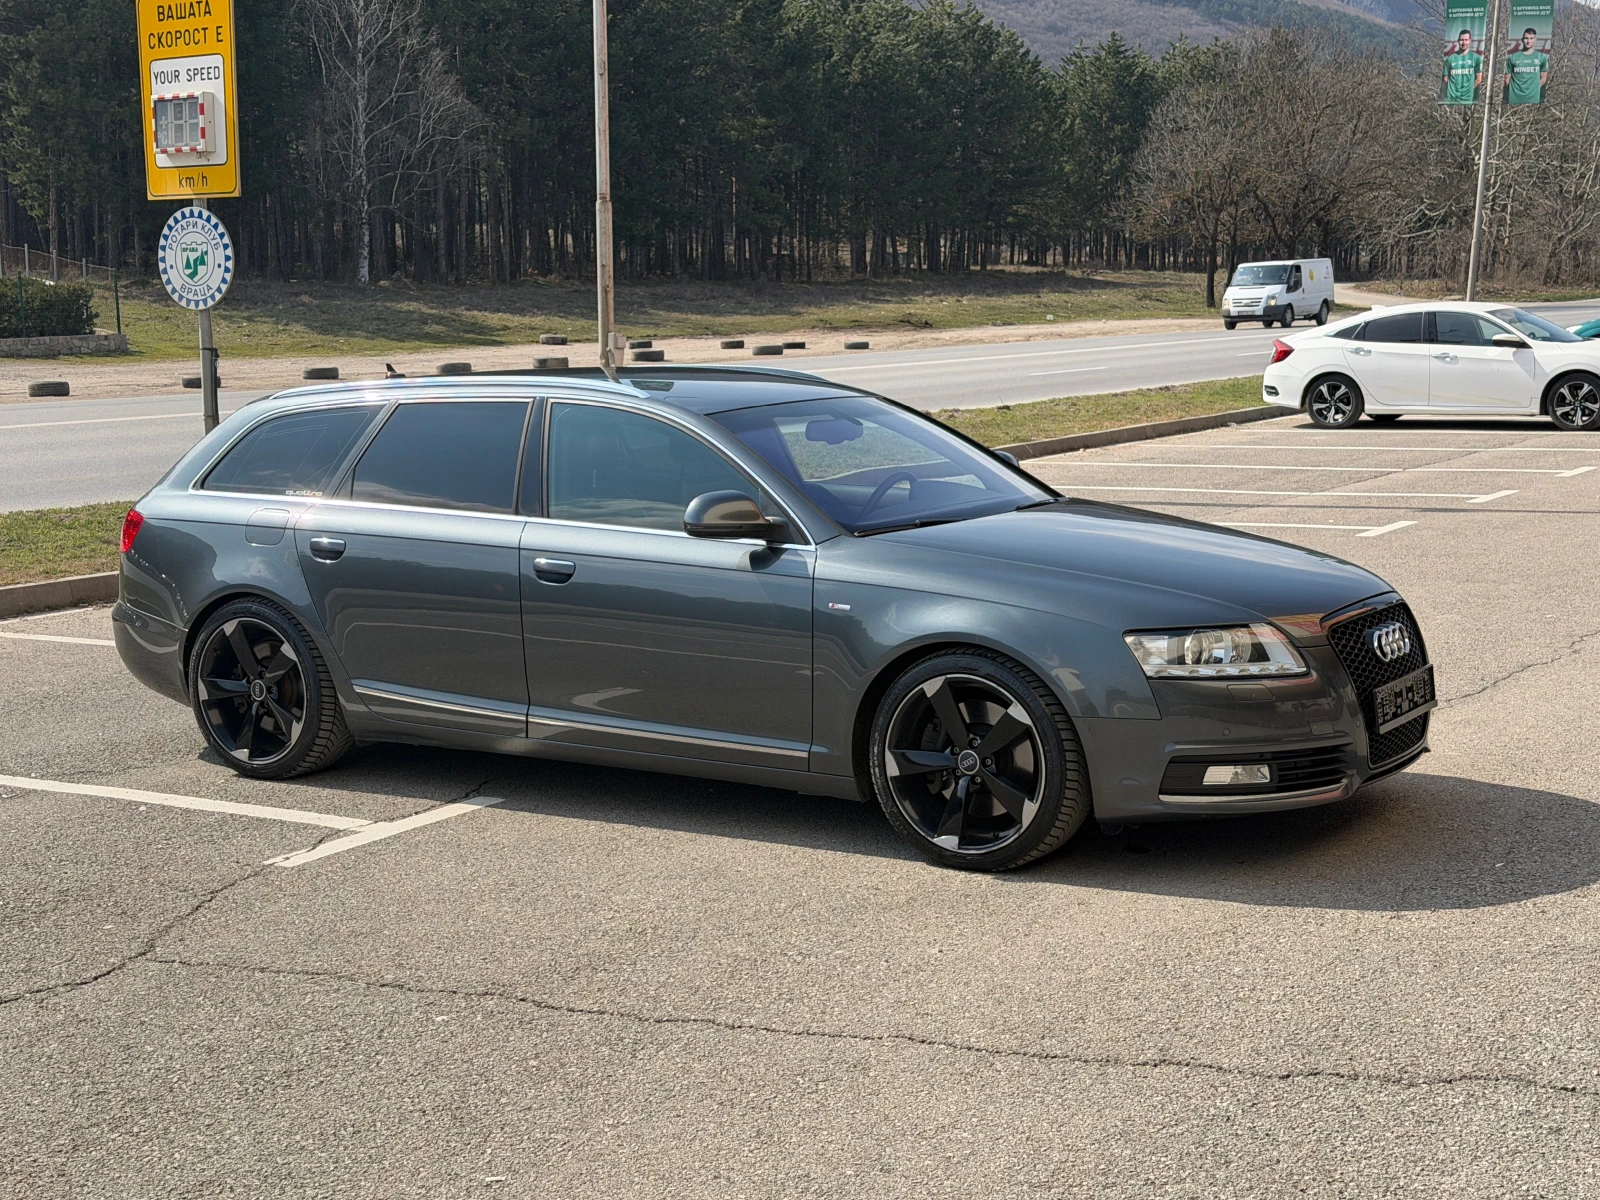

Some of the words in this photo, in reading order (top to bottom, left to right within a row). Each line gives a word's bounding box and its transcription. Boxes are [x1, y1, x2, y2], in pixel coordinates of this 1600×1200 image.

[157, 1, 212, 22] ВАШАТА
[148, 27, 209, 50] СКОРОСТ
[216, 25, 224, 43] Е
[153, 70, 181, 85] YOUR
[186, 65, 221, 82] SPEED
[178, 172, 208, 188] km/h
[168, 220, 198, 251] РОТАРИ
[200, 222, 221, 251] КЛУБ
[179, 283, 213, 298] ВРАЦА
